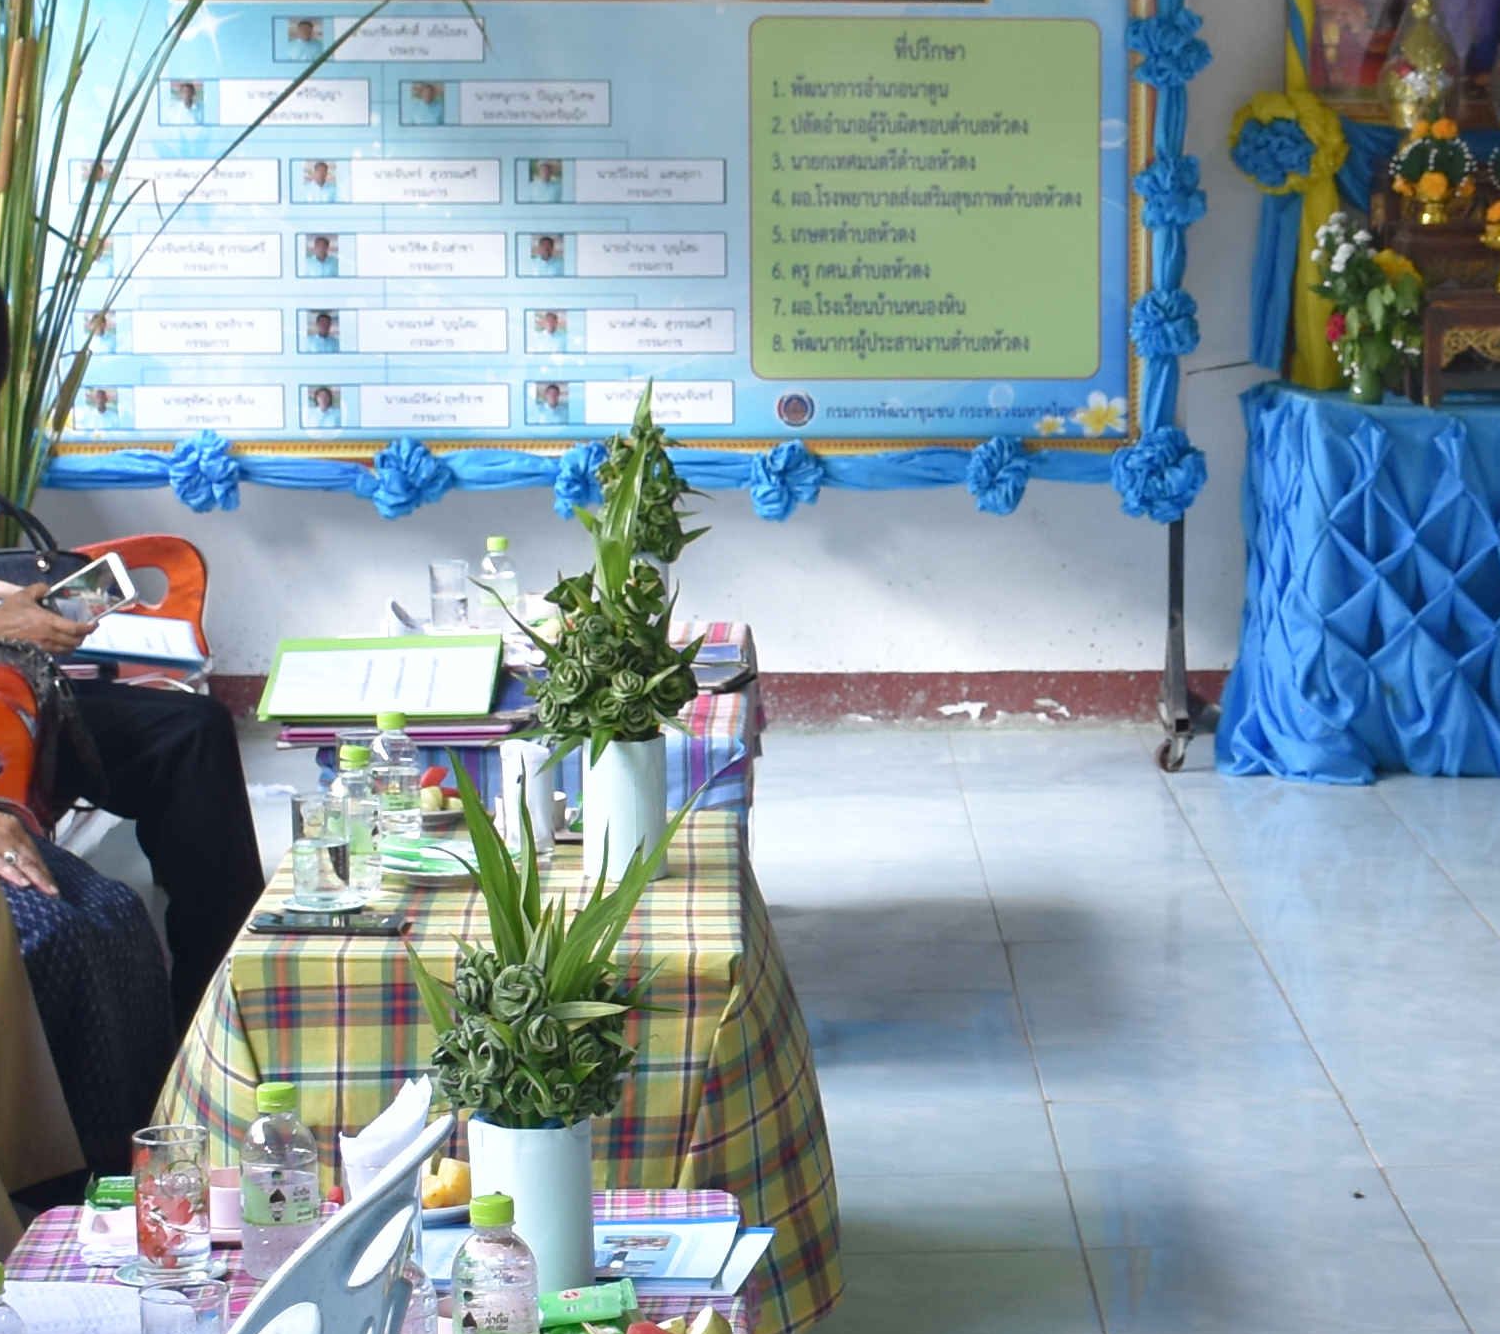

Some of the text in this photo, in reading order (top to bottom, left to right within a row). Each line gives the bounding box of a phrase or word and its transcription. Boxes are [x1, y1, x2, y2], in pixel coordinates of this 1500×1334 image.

[893, 32, 966, 63] ที่ปรึกษา
[771, 80, 786, 98] 1.
[771, 117, 786, 135] 2.
[771, 154, 786, 172] 3.
[770, 190, 786, 208] 4.
[771, 226, 786, 244] 5.
[771, 262, 786, 280] 6.
[772, 299, 786, 317] 7.
[771, 335, 786, 353] 8.
